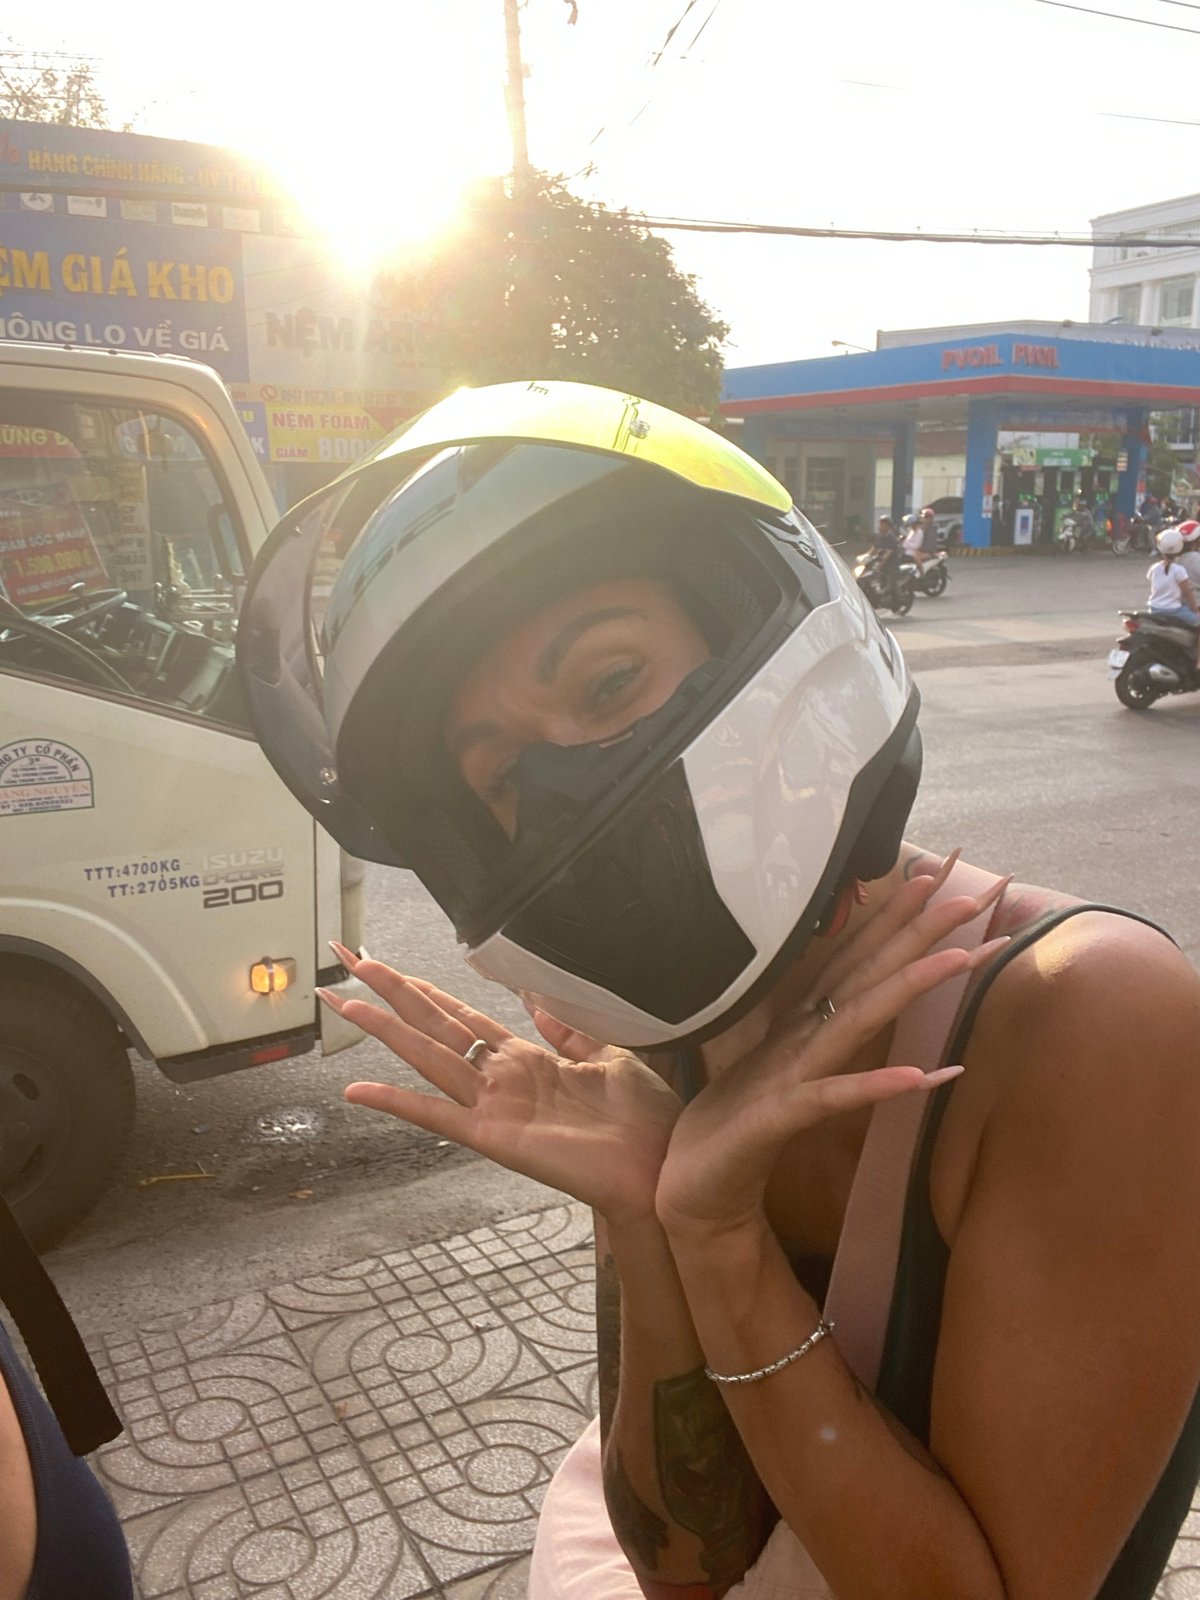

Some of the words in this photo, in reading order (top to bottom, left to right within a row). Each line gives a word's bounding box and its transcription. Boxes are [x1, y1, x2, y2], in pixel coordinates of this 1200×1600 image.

[61, 247, 137, 297] GIÁ
[147, 261, 235, 304] KHO
[85, 323, 126, 345] LO
[133, 320, 173, 348] VỀ
[179, 326, 231, 352] GIÁ
[321, 414, 369, 430] FOAM
[84, 859, 181, 882] TTT:4700KG
[203, 848, 283, 871] ISUZU
[107, 875, 200, 898] TT:2705KG
[203, 880, 284, 909] 200
